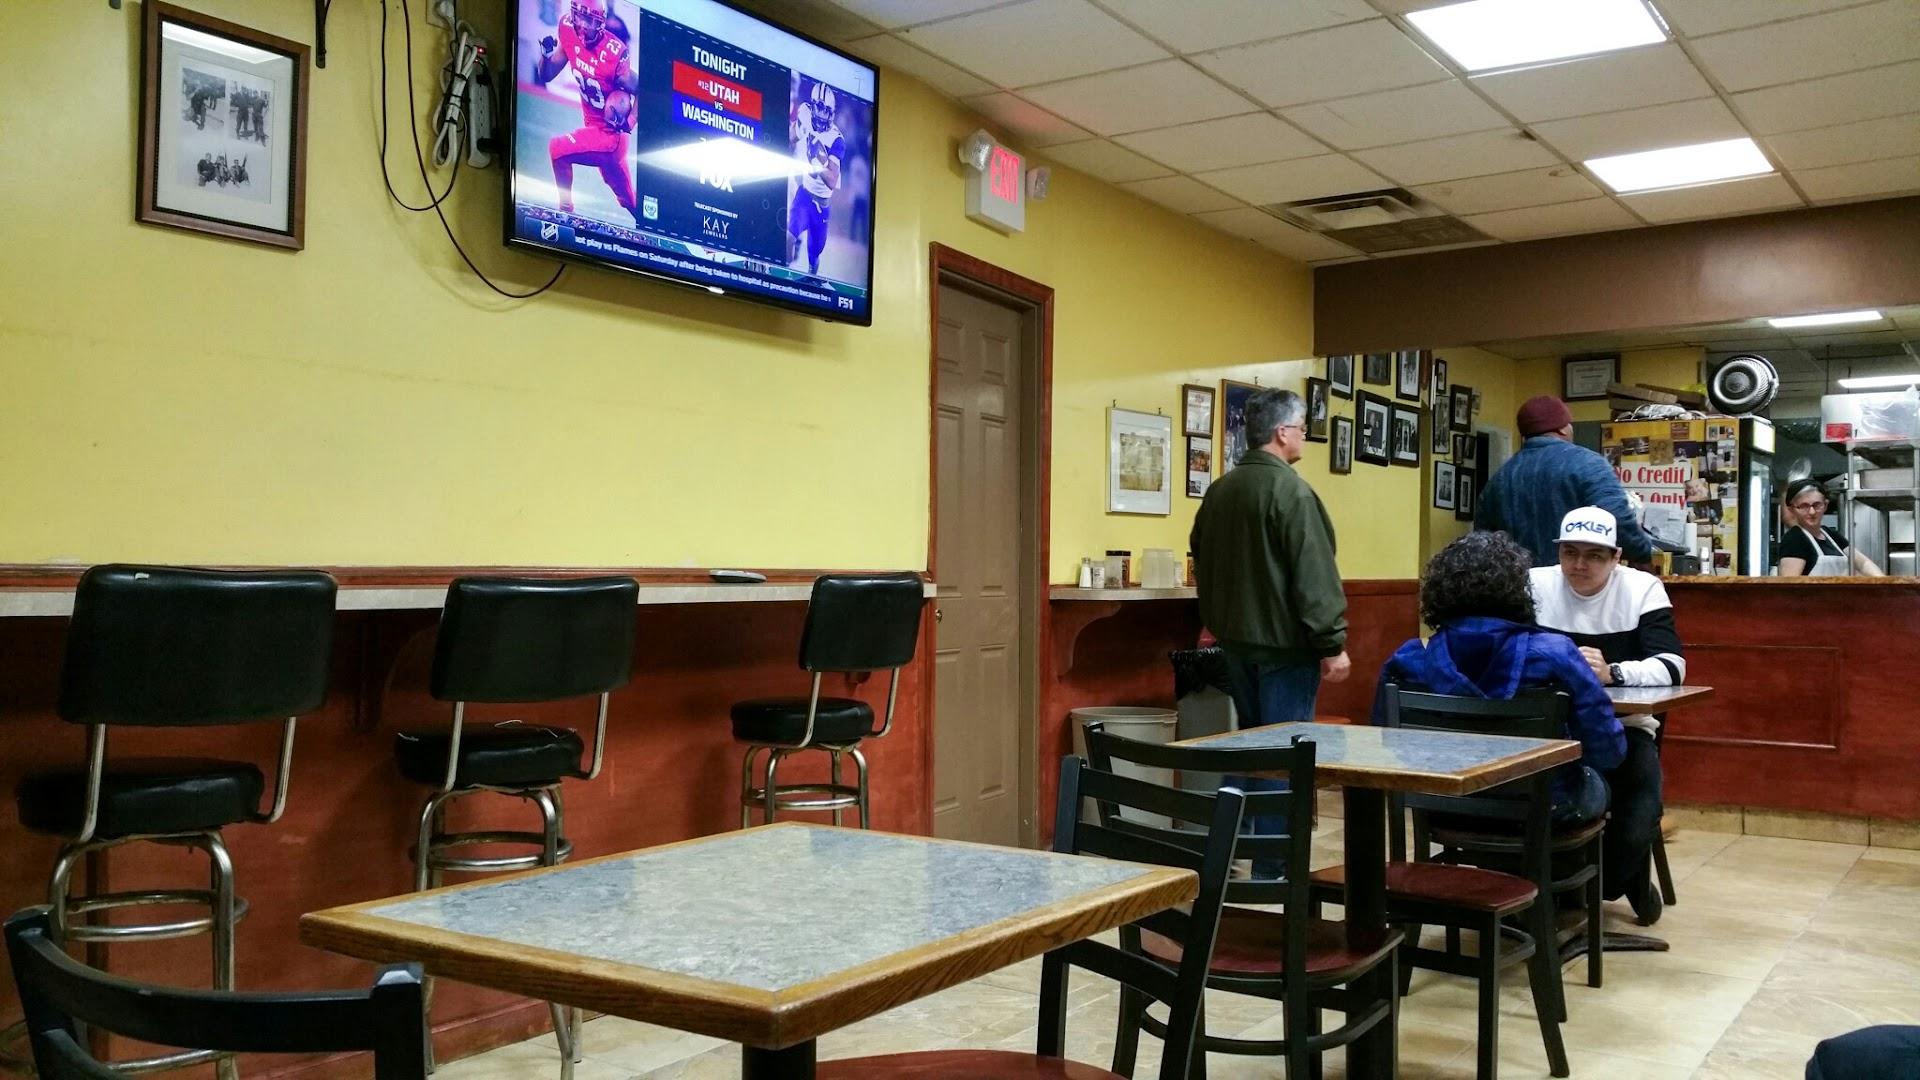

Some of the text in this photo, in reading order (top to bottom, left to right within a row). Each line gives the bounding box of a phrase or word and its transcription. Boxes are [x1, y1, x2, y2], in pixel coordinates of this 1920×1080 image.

[692, 45, 747, 80] TONIGHT
[709, 80, 740, 104] UTAH
[682, 102, 754, 140] WASHINGTON
[990, 146, 1019, 206] EXIT
[703, 215, 730, 234] KAY
[586, 238, 602, 250] play
[603, 243, 612, 251] vs
[612, 244, 639, 257] Flames
[638, 251, 648, 259] on
[648, 252, 678, 268] Saturday
[678, 260, 694, 270] after
[694, 263, 713, 276] being
[713, 268, 730, 279] taken
[730, 272, 738, 280] to
[738, 274, 761, 286] hospital
[799, 288, 820, 300] because
[838, 296, 853, 310] FS1
[1637, 466, 1685, 484] Credit
[1565, 520, 1612, 536] OAKLEY
